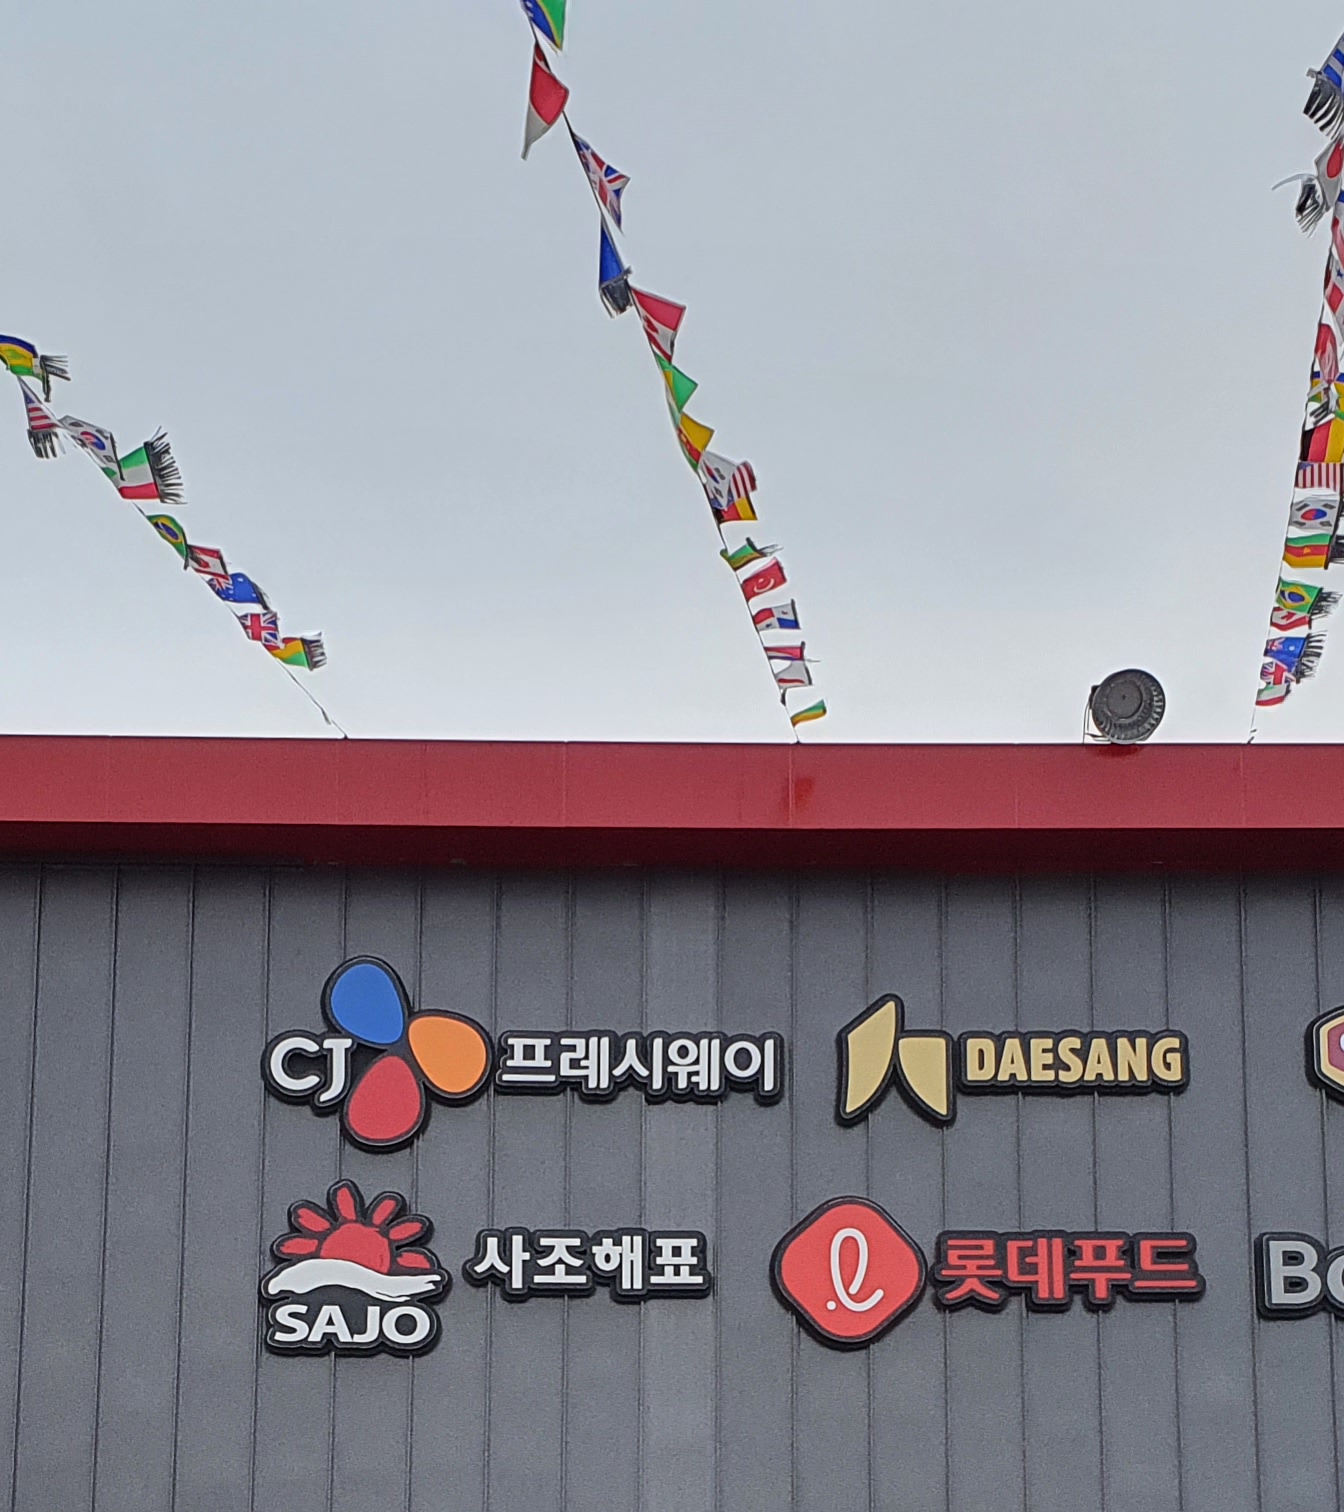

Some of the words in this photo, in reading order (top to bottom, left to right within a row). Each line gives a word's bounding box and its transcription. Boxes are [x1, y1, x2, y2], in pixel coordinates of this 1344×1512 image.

[271, 1037, 352, 1103] CJ
[501, 1035, 775, 1092] 프레시웨이
[966, 1037, 1183, 1082] DAESANG
[474, 1234, 705, 1292] 사조해표
[941, 1238, 1199, 1301] 롯데푸드
[274, 1304, 431, 1344] SAJO
